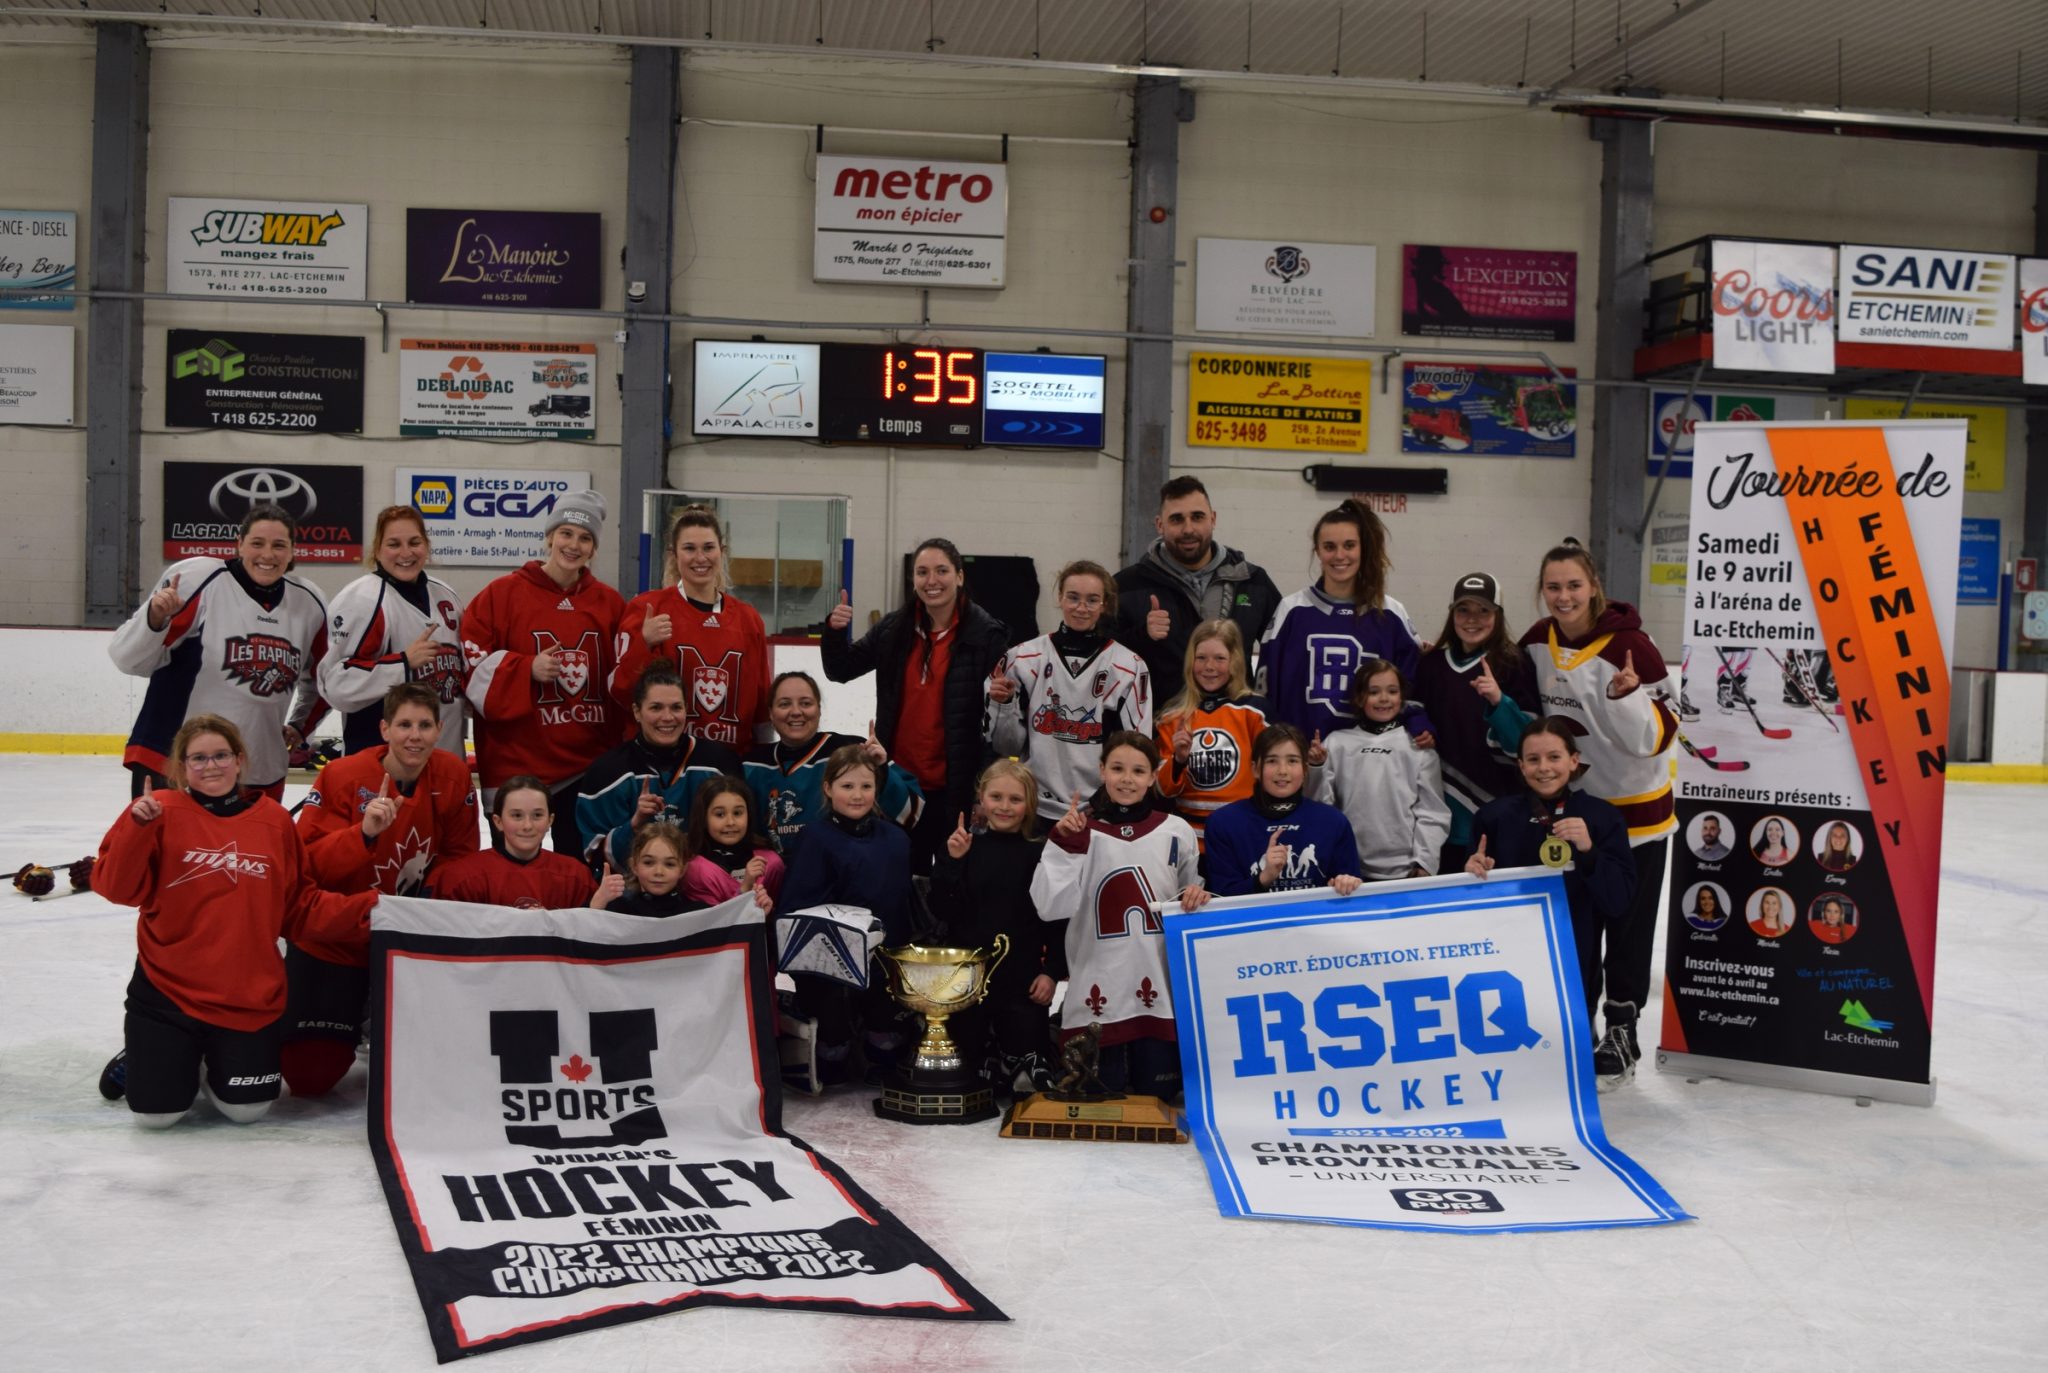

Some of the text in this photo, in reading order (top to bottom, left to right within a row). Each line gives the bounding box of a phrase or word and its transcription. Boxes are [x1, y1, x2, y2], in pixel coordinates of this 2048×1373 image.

[833, 165, 993, 204] metro
[856, 206, 963, 226] mon épicier
[33, 221, 68, 237] DIESEL
[191, 209, 345, 247] SUBWAY
[221, 249, 315, 261] mangez frais
[475, 233, 569, 266] Manoir
[852, 240, 974, 257] Marché O Frigidaire
[31, 257, 66, 274] Ben
[833, 256, 855, 265] 1575,
[857, 257, 883, 265] Route
[885, 257, 901, 265] 277
[188, 269, 217, 279] 1573,
[221, 270, 240, 278] RTE
[270, 271, 345, 281] LAC-ETCHEMIN
[882, 267, 941, 277] Lac-Etchemin
[1453, 266, 1569, 287] L'EXCEPTION
[1851, 253, 1978, 291] SANI
[241, 284, 327, 294] 418-625-3200
[1711, 269, 1834, 321] Coors
[1847, 301, 1964, 325] ETCHEMIN
[1735, 319, 1814, 345] LIGHT
[1859, 325, 1969, 341] sanietchemin.com
[713, 352, 797, 360] IMPRIMERIE
[249, 364, 352, 380] CONSTRUCTION
[1198, 358, 1312, 378] CORDONNERIE
[417, 377, 514, 394] DEBLOUBAC
[532, 372, 589, 385] BEAUCE
[884, 351, 975, 404] 1:35
[991, 380, 1076, 391] SOGETEL
[206, 389, 323, 400] ENTREPRENEUR GÉNÉRAL
[1029, 390, 1097, 399] MOBILITÉ
[1257, 381, 1361, 400] La Bottine
[211, 412, 317, 427] T 418 625-2200
[1206, 404, 1354, 420] AIGUISAGE DE PATINS
[701, 418, 802, 430] APPALACHES
[879, 417, 922, 436] temps
[1196, 420, 1267, 442] 625-3498
[1295, 435, 1357, 447] Lac-Etchemin
[464, 477, 568, 492] PIÈCES D'AUTO
[1707, 452, 1950, 510] Journée de
[421, 490, 447, 505] NAPA
[463, 528, 496, 540] Armagh
[1698, 532, 1779, 554] Samedi
[471, 547, 488, 556] Baie
[491, 548, 519, 557] St-Paul
[528, 549, 537, 557] La
[1697, 560, 1716, 582] le
[1723, 561, 1737, 582] 9
[1743, 561, 1792, 582] avril
[1694, 591, 1801, 611] à l'aréna de
[437, 600, 457, 631] C
[1693, 620, 1815, 640] Lac-Etchemin
[230, 642, 253, 662] LES
[417, 662, 434, 679] LES
[539, 704, 605, 726] McGill
[1360, 747, 1392, 755] CCM
[1682, 781, 1770, 801] Entraîneurs
[1774, 788, 1842, 806] présents
[182, 851, 270, 873] TITANS
[1237, 938, 1500, 980] SPORT. ÉDUCATION. FIERTÉ.
[1685, 955, 1775, 978] Inscrivez-vous
[1692, 974, 1767, 989] avant le 6 avril au
[1679, 986, 1780, 1006] www.lac-etchemin.ca
[297, 1021, 354, 1032] EASTON
[1225, 970, 1543, 1078] RSEQ
[1824, 1030, 1899, 1049] Lac-Etchemin
[1273, 1069, 1504, 1120] HOCKEY
[501, 1084, 656, 1124] SPORTS
[1330, 1127, 1464, 1138] 2021-2022
[533, 1150, 678, 1167] WOMEN'S
[1250, 1141, 1568, 1158] CHAMPIONNES
[1255, 1155, 1581, 1171] PROVINCIALES
[1313, 1171, 1548, 1184] UNIVERSITAIRE
[442, 1159, 794, 1223] HOCKEY
[1404, 1190, 1483, 1203] GO
[1409, 1201, 1491, 1211] PURE
[584, 1213, 722, 1239] FÉMININ
[504, 1232, 830, 1270] 2022 CHAMPIONS
[491, 1249, 876, 1297] CHAMPIONNES 2022
